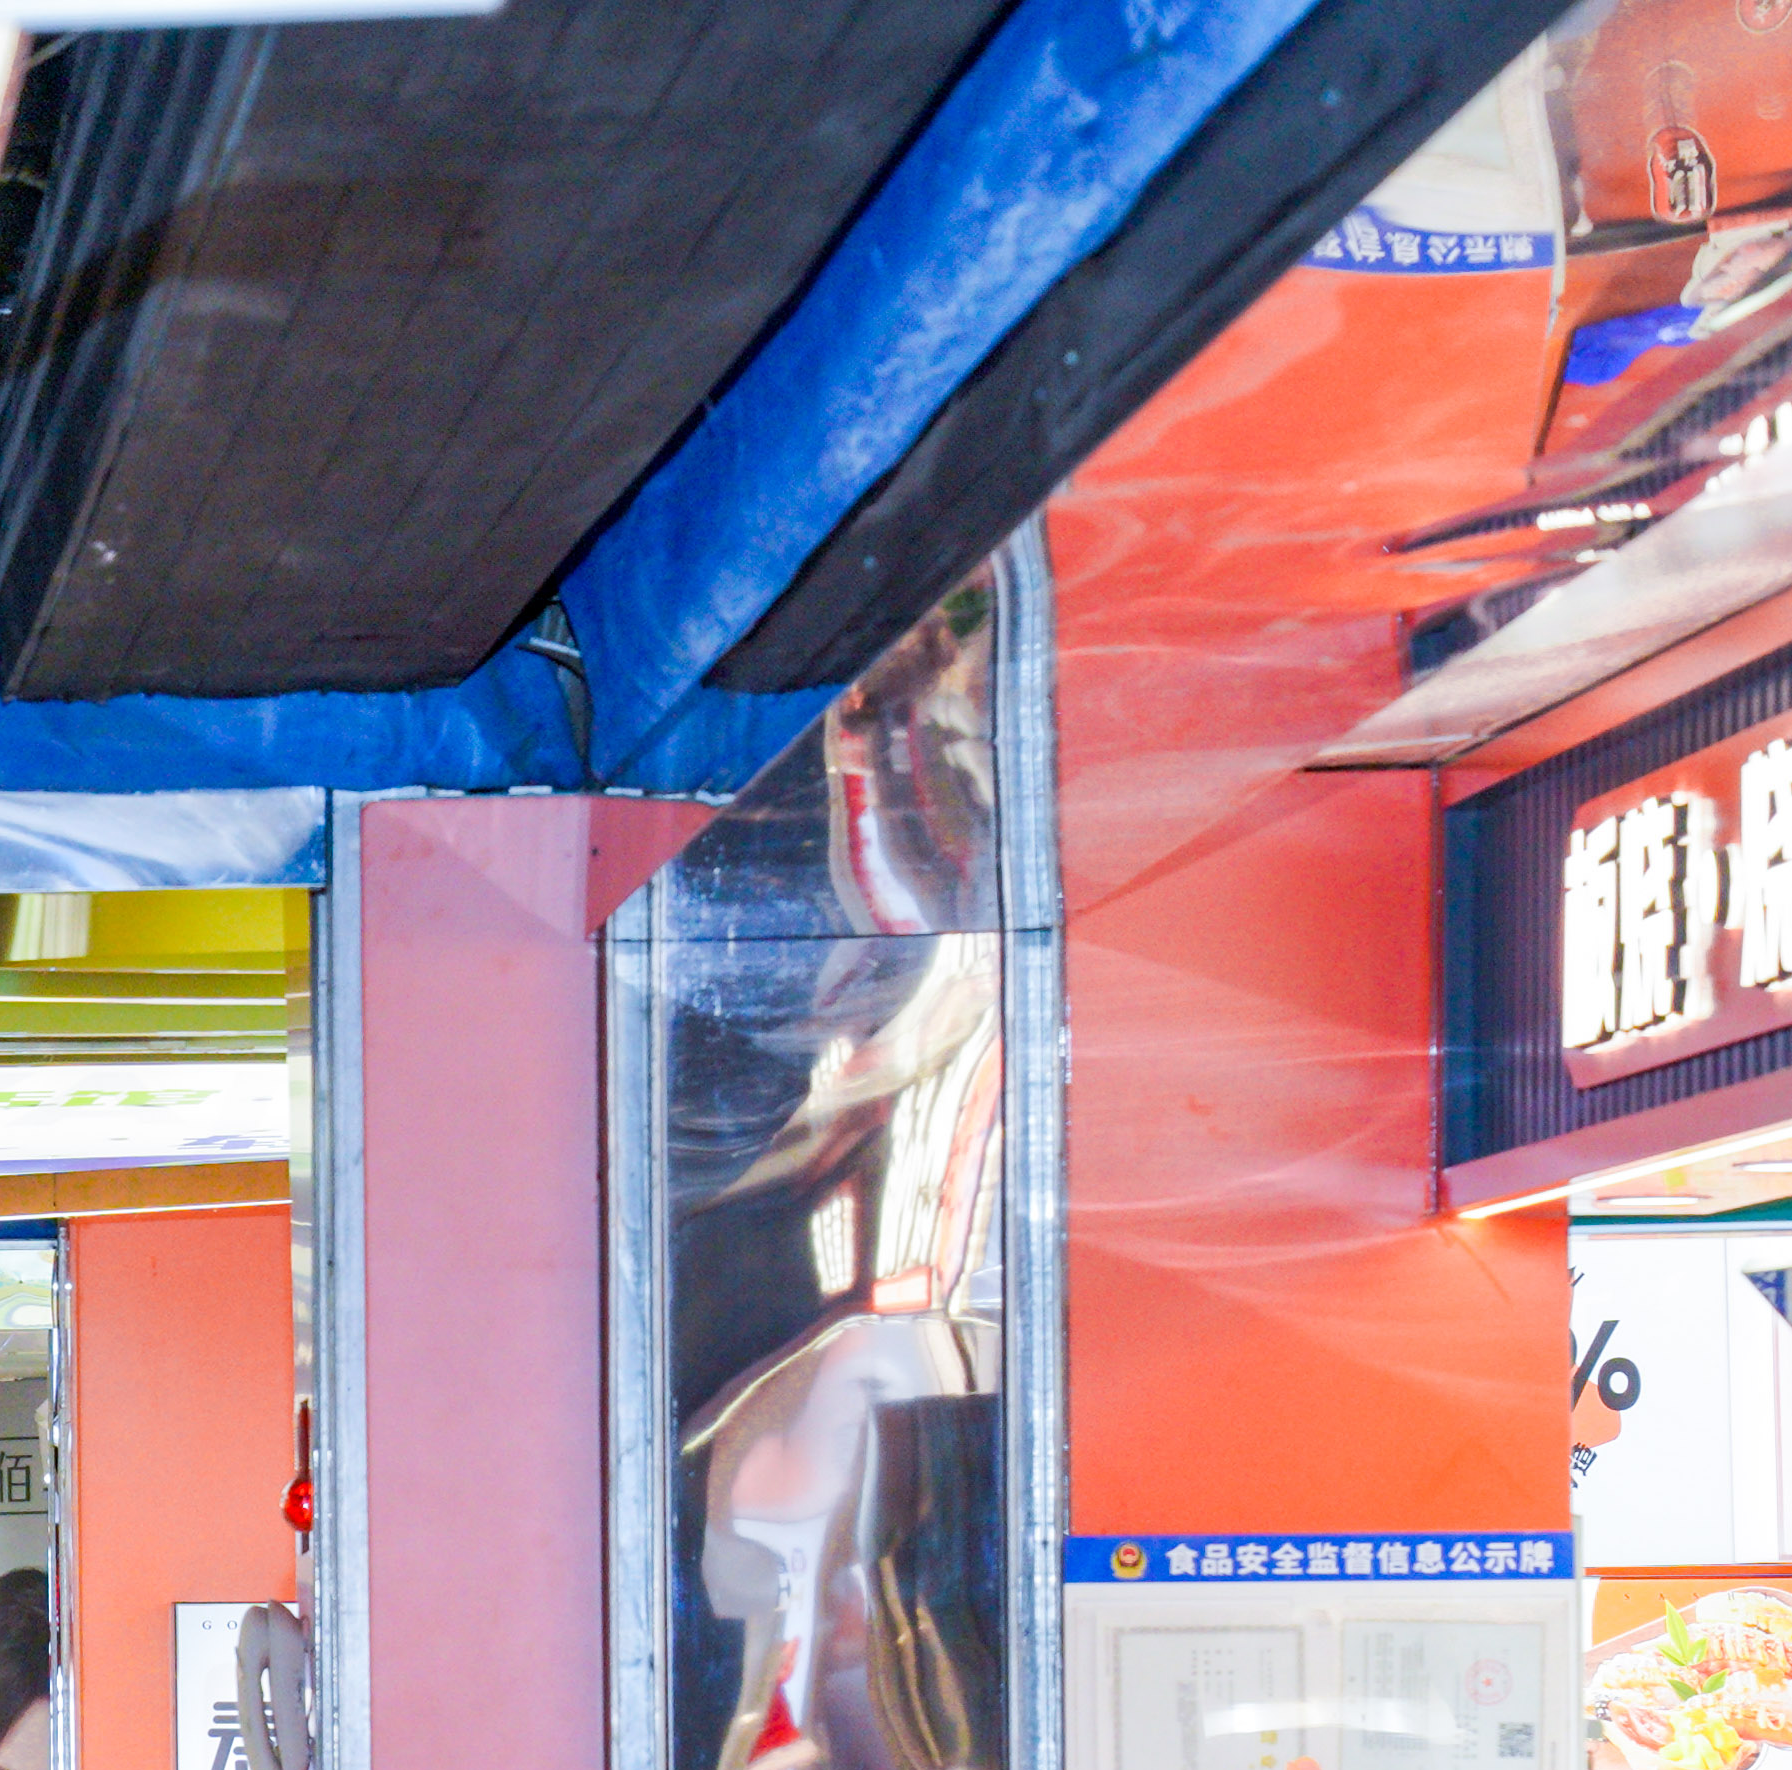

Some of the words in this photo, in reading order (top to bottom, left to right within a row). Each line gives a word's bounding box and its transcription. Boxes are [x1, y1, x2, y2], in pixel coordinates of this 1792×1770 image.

[1165, 1540, 1555, 1577] 食品安全监督信息公示牌
